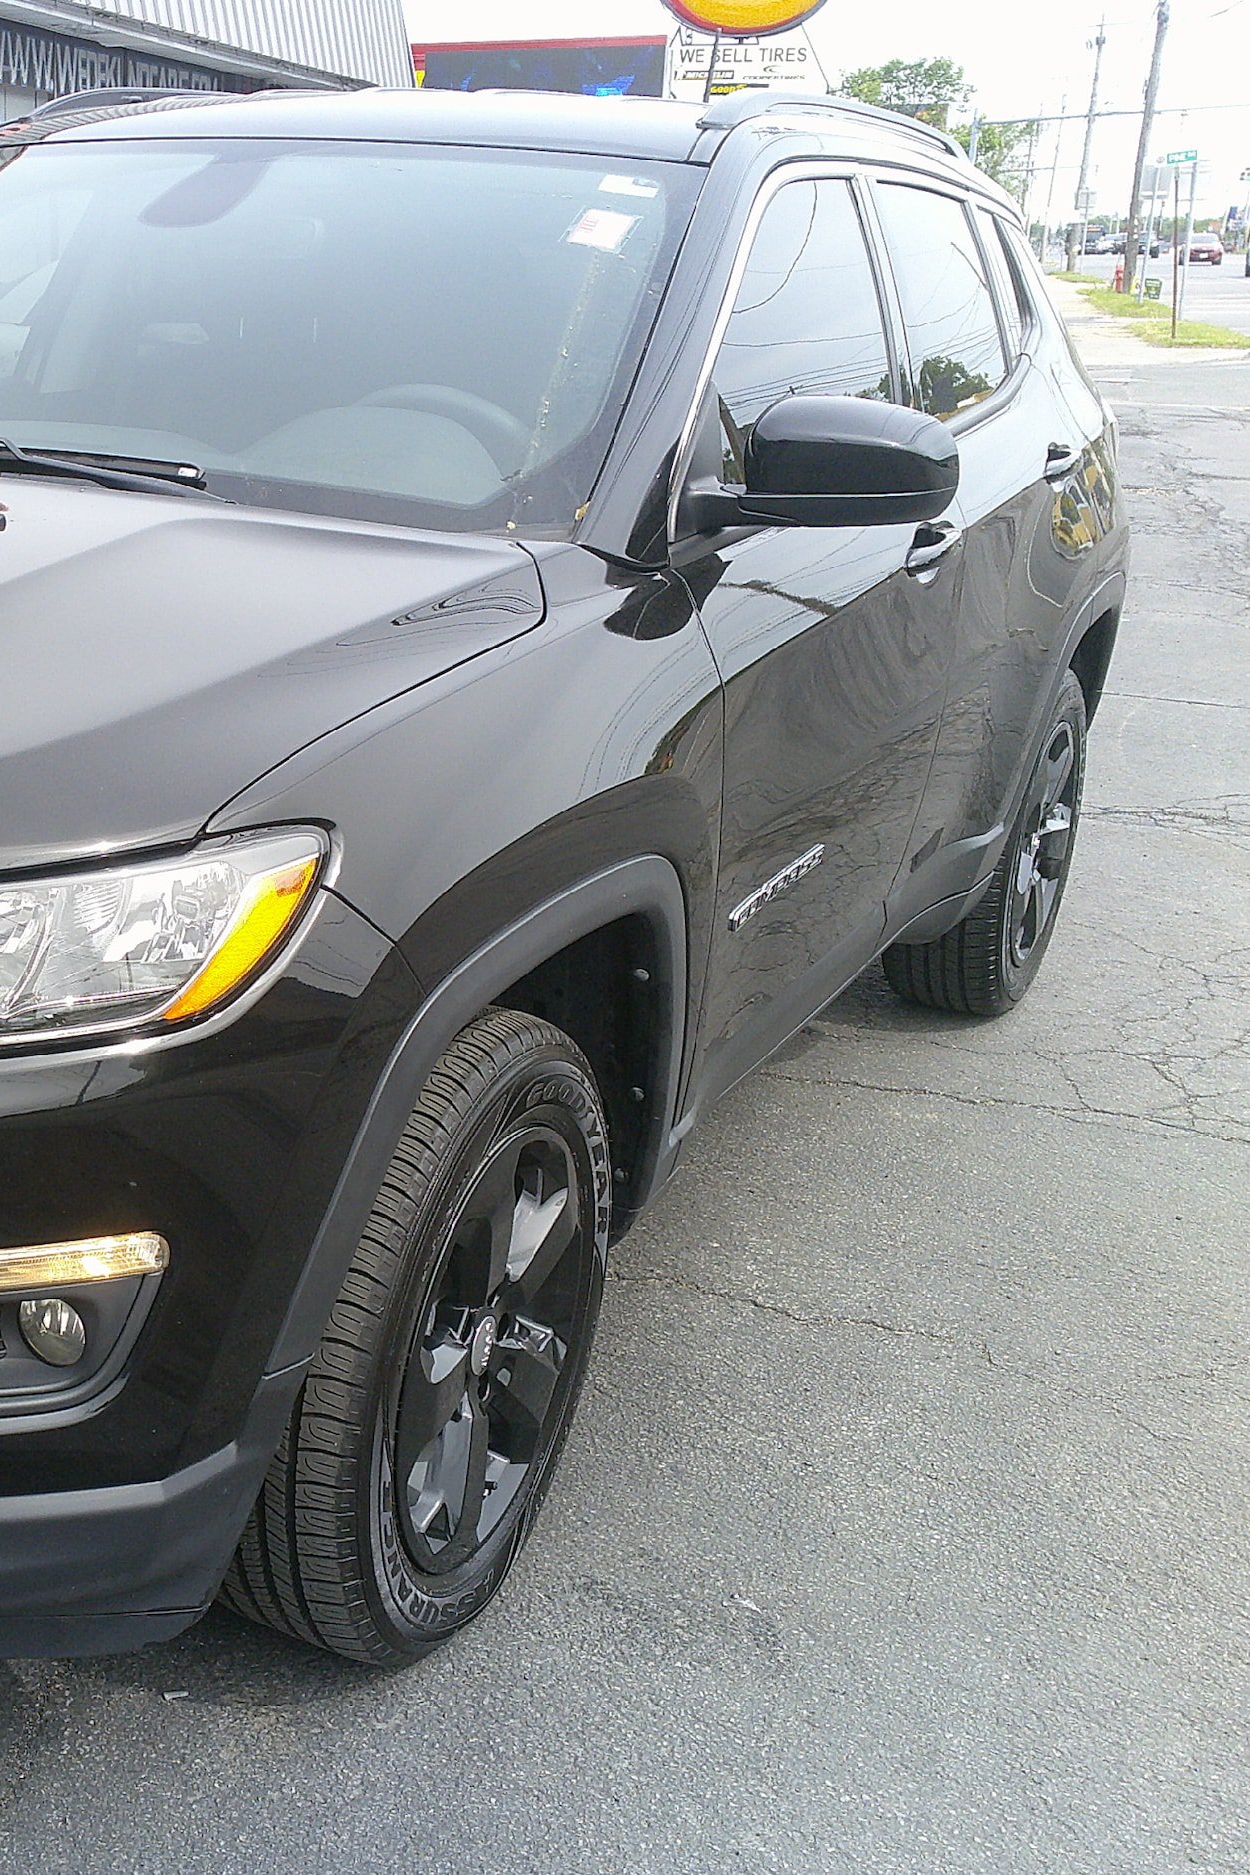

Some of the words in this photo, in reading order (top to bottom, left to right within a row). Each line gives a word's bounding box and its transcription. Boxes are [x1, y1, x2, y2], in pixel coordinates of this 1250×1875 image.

[680, 48, 705, 63] WE
[713, 47, 753, 63] SELL
[759, 47, 807, 63] TIRES
[526, 1079, 608, 1235] GOODYEAR
